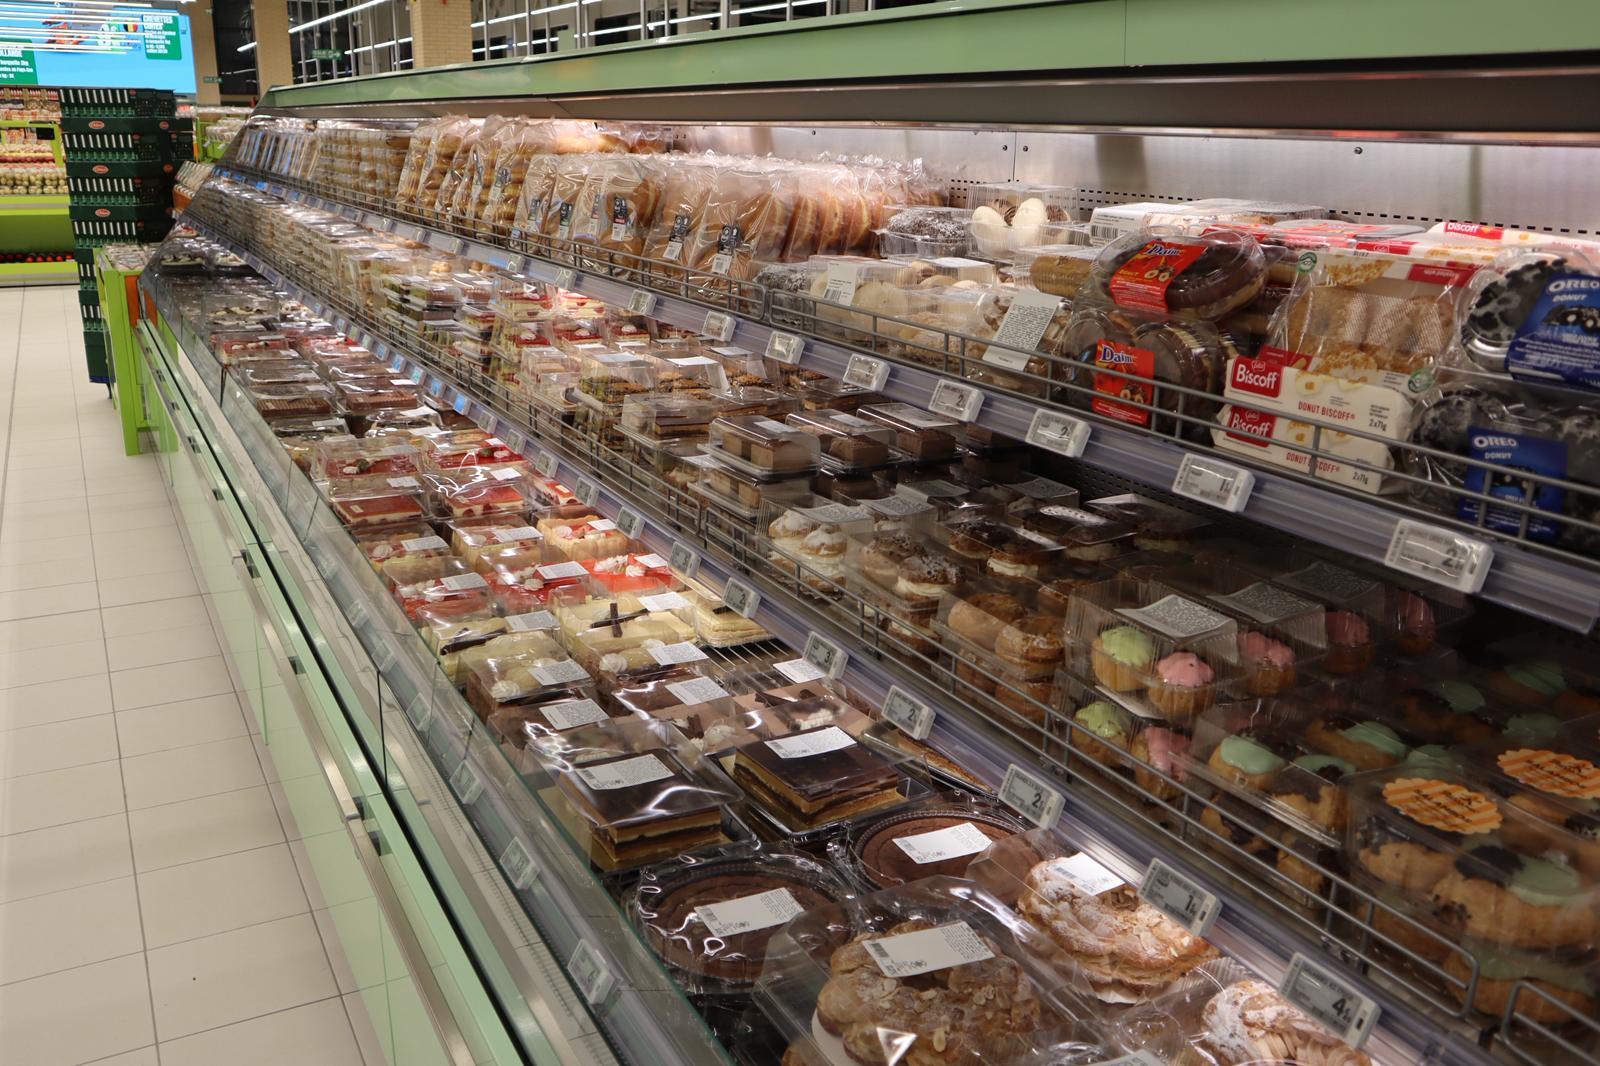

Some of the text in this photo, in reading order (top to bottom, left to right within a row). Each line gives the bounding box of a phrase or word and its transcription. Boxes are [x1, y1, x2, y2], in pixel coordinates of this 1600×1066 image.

[1145, 243, 1180, 256] Daim
[1548, 279, 1600, 292] OREO
[1552, 294, 1588, 303] DONUT
[1100, 344, 1134, 364] Daim
[1236, 363, 1278, 390] Biscoff
[1298, 401, 1320, 413] DONUT
[1231, 413, 1271, 438] Biscoff
[1473, 436, 1517, 448] OREO
[1286, 452, 1308, 465] DONUT
[1484, 452, 1512, 460] DONUT
